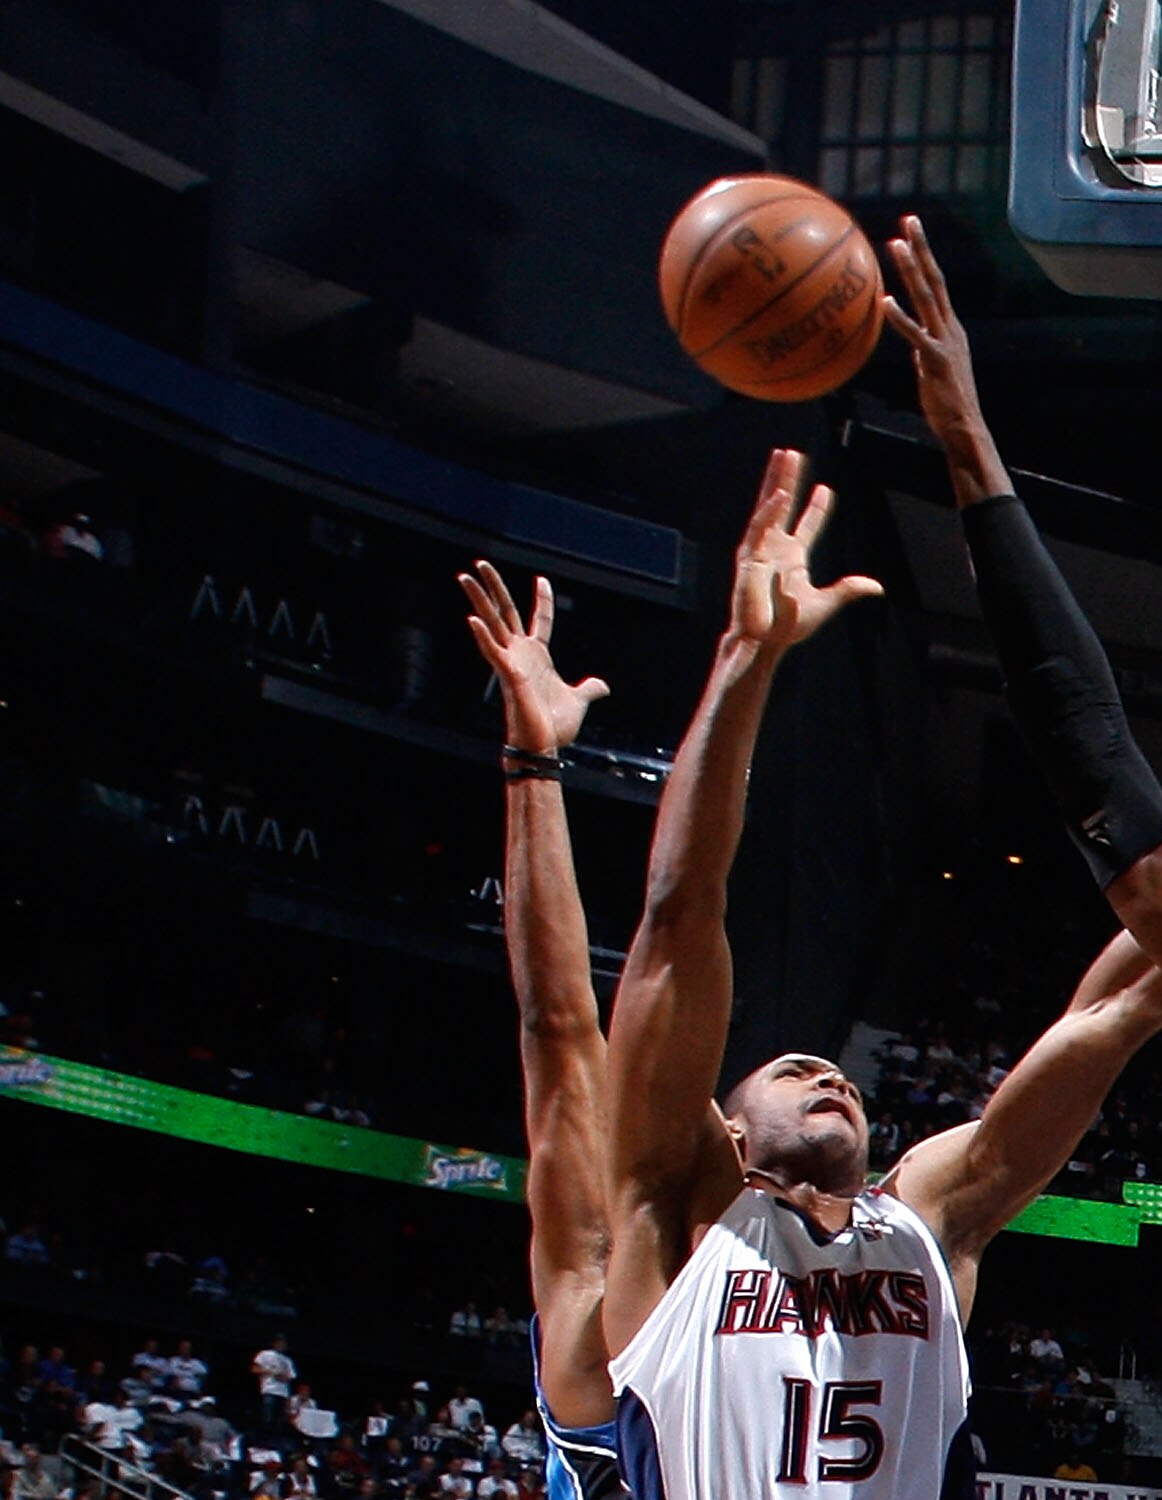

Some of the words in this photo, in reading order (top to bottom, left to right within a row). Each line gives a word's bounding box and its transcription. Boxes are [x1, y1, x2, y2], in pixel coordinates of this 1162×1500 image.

[714, 1268, 930, 1341] HAWKS
[411, 1435, 444, 1453] 107
[776, 1373, 885, 1485] 15
